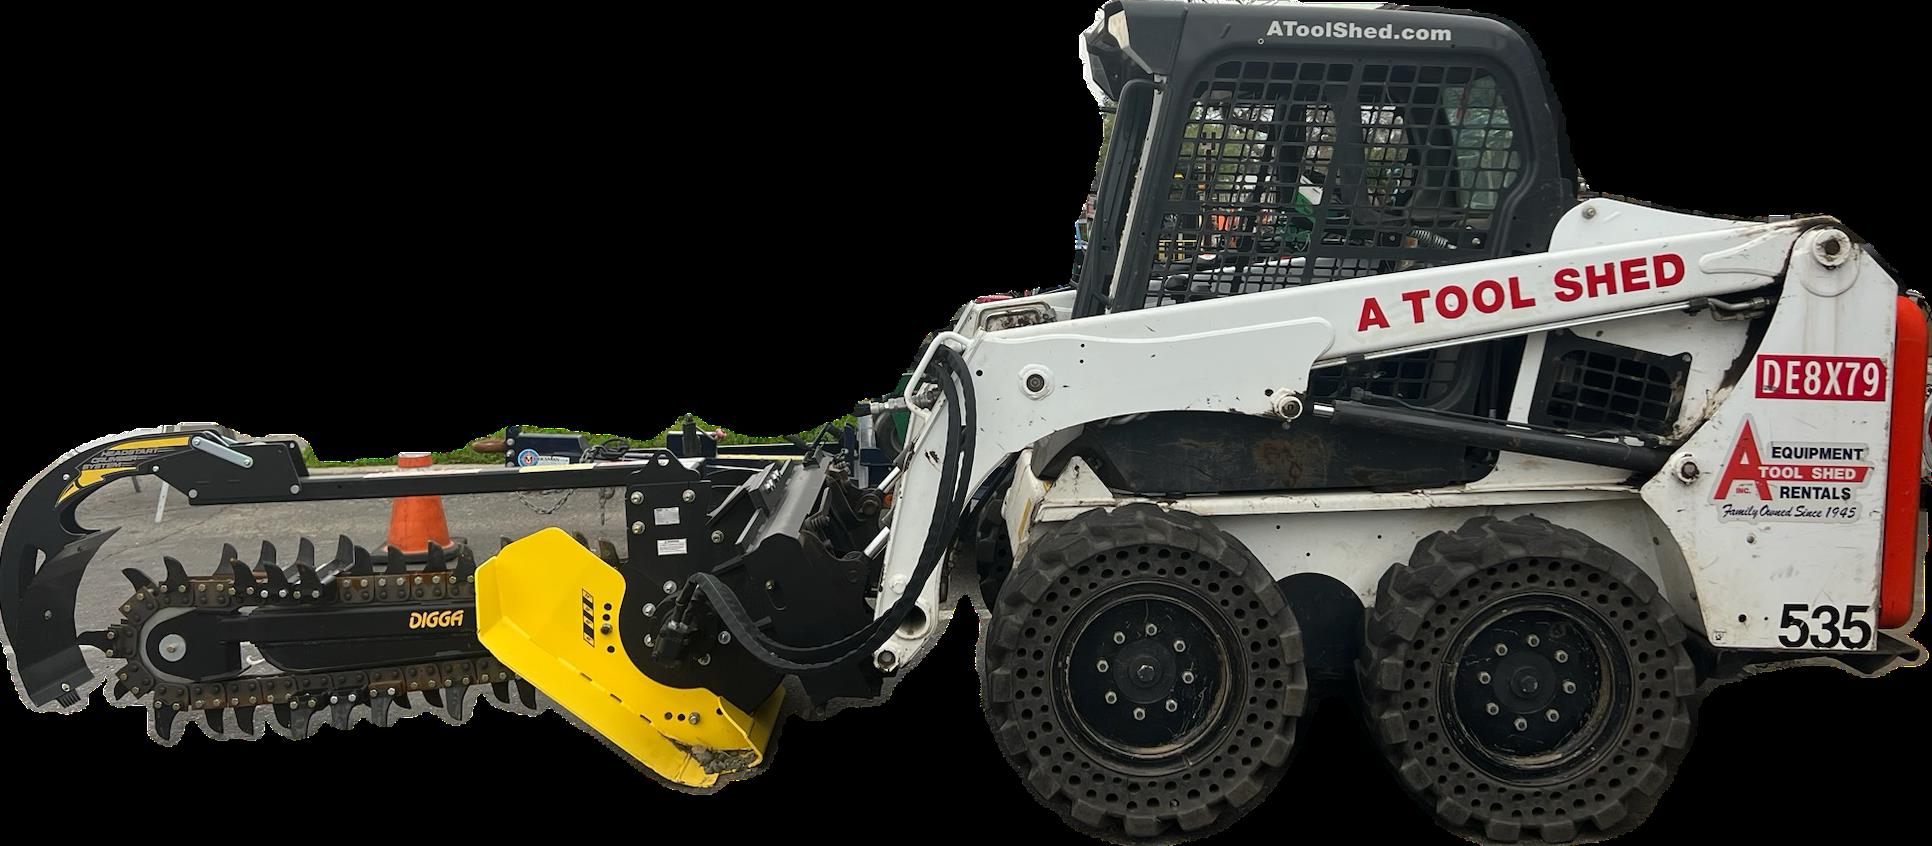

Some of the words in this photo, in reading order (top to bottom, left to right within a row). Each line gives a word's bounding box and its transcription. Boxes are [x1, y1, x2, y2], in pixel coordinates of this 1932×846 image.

[1267, 20, 1452, 41] AToolShed.com
[1357, 297, 1391, 332] A
[1402, 276, 1536, 324] TOOL
[1553, 253, 1686, 303] SHED
[1762, 359, 1880, 397] DE8X79
[1713, 419, 1773, 501] A
[1758, 466, 1803, 479] TOOL
[1811, 468, 1856, 480] SHED
[1771, 446, 1864, 461] EQUIPMENT
[1780, 486, 1851, 500] RENTALS
[1722, 504, 1758, 519] Family
[1759, 504, 1792, 518] Owned
[1794, 505, 1822, 518] Since
[1825, 507, 1856, 519] 1945
[409, 609, 464, 629] DIGGA
[1778, 604, 1872, 649] 535
